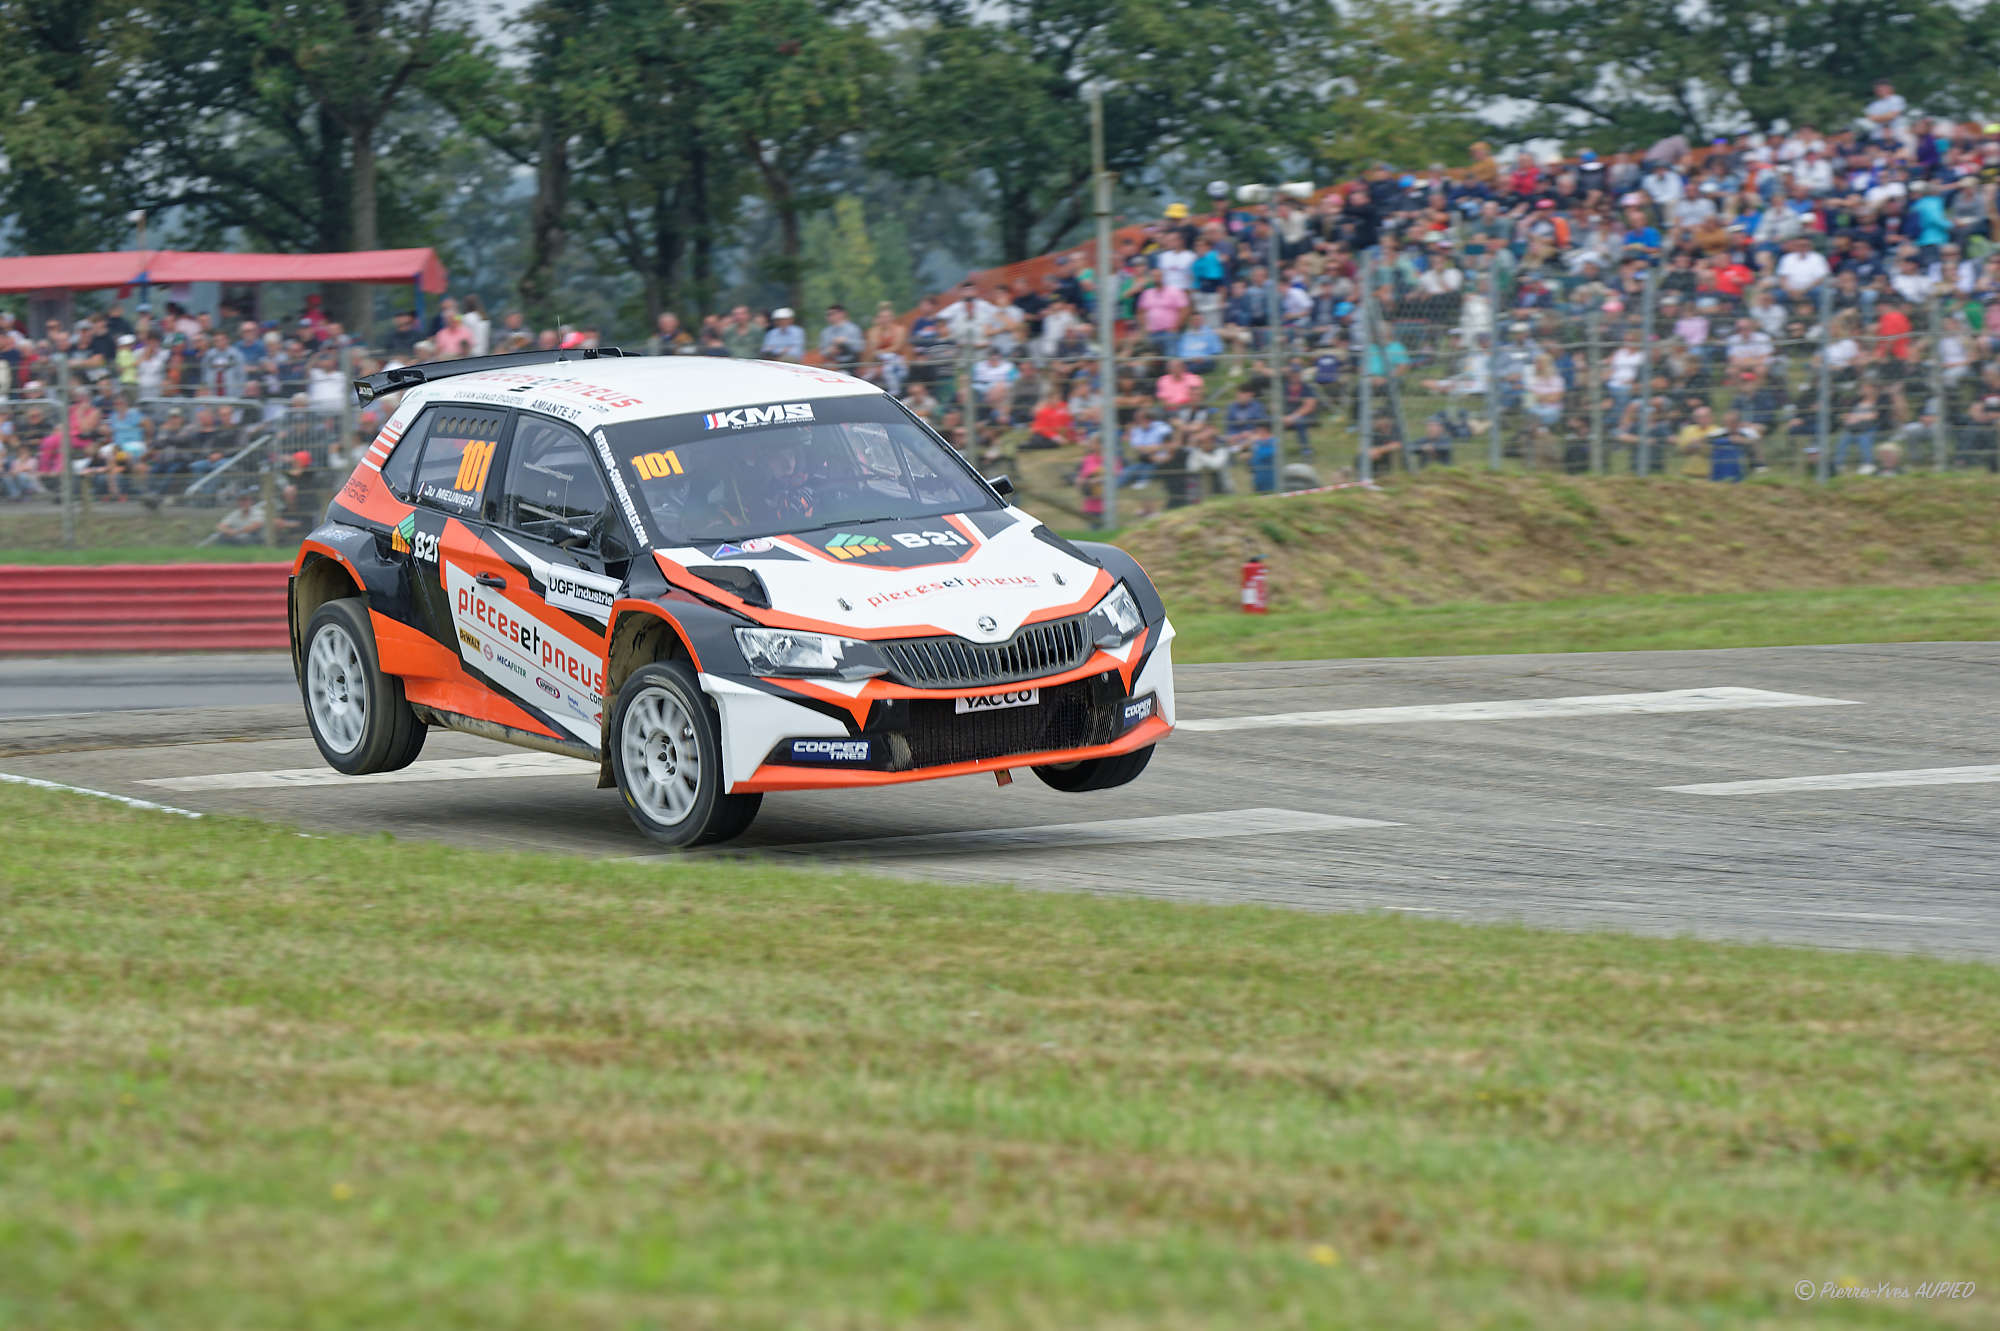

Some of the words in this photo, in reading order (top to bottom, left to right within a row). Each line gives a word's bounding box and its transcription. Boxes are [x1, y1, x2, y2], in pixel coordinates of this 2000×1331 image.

[454, 440, 496, 492] 101
[631, 450, 685, 480] 101
[435, 488, 475, 508] MEUNIER
[549, 576, 574, 596] UGF
[574, 583, 615, 607] industrie
[867, 576, 1036, 607] piecesetpneus
[496, 654, 527, 679] MECAFILTER
[964, 689, 1032, 709] YACCO
[793, 741, 869, 753] COOPER
